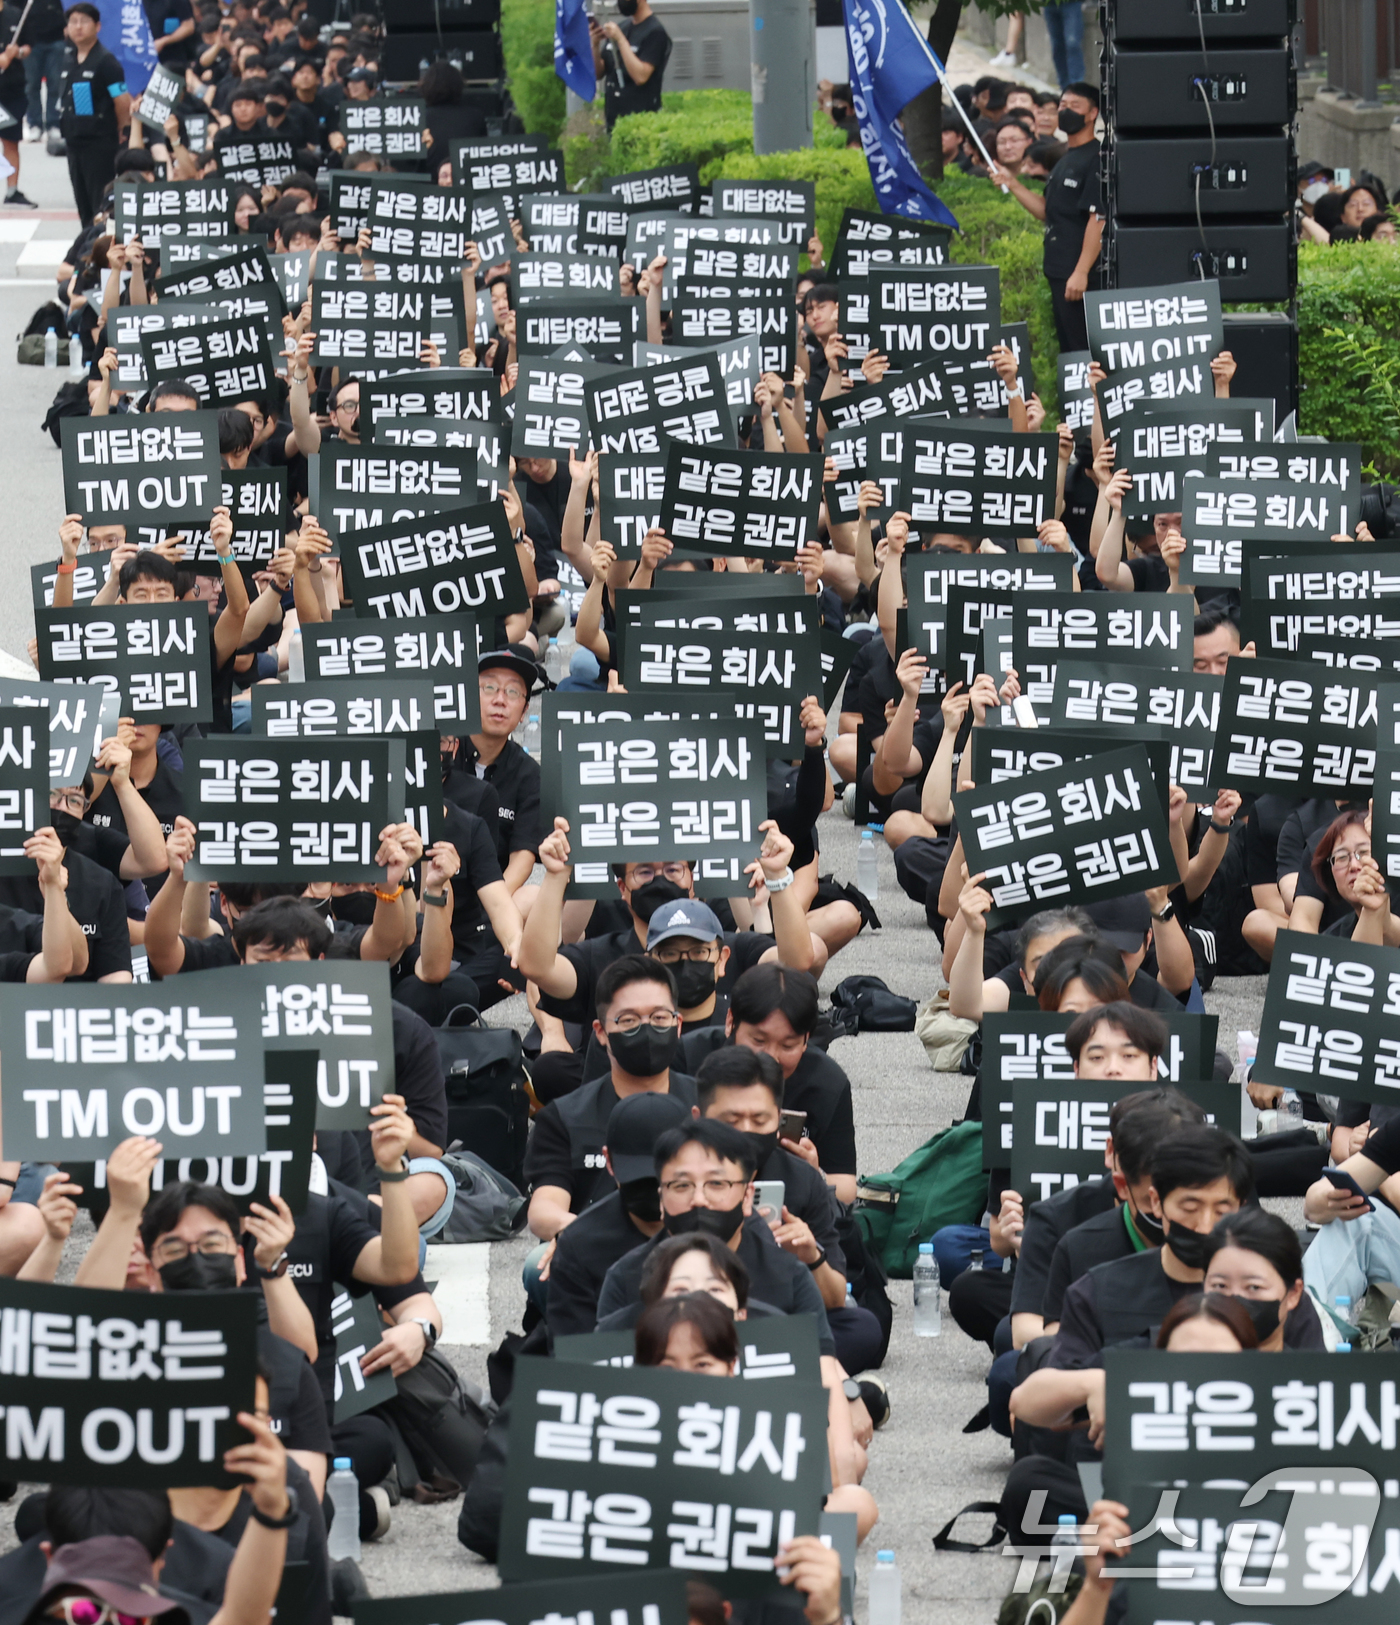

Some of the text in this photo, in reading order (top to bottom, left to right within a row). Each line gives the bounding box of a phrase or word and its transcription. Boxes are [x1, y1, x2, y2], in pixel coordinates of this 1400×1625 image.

[346, 107, 420, 128] 같은 회사
[220, 143, 291, 167] 같은 회사
[348, 133, 420, 154] 같은 권리
[264, 166, 296, 186] 권리
[471, 160, 557, 189] 같은 회사
[143, 189, 228, 216] 같은 회사
[376, 191, 416, 220] 같은
[422, 196, 466, 223] 회사
[723, 189, 805, 213] 대답없는
[372, 226, 464, 258] 같은 권리
[586, 211, 628, 235] 대답
[778, 223, 806, 243] UT
[478, 233, 504, 260] UT
[694, 250, 790, 278] 같은 회사
[214, 258, 263, 289] 회사
[519, 262, 613, 290] 같은 회사
[321, 291, 368, 319] 같은
[374, 292, 423, 320] 회사
[882, 282, 987, 311] 대답없는
[1099, 296, 1207, 329] 대답없는
[527, 317, 621, 344] 대답없는
[682, 307, 787, 339] 같은 회사
[880, 323, 989, 350] TM OUT
[152, 327, 258, 369] 같은 회사
[319, 329, 421, 358] 같은 권리
[1101, 341, 1145, 369] TM
[215, 364, 266, 397] 권리
[529, 371, 584, 405] 같은
[889, 373, 946, 418] 회사
[1104, 365, 1202, 419] 같은 회사
[434, 391, 490, 420] 회사
[78, 427, 203, 464] 대답없는
[525, 414, 580, 449] 같은
[336, 459, 461, 495] 대답없는
[915, 440, 975, 477] 같은
[984, 446, 1047, 480] 회사
[1288, 457, 1349, 491] 회사
[78, 475, 207, 512] TM OUT
[238, 482, 280, 515] 회사
[679, 457, 812, 502] 같은 회사
[1133, 471, 1175, 502] TM
[912, 488, 1043, 526] 같은 권리
[1196, 492, 1328, 530] 같은 회사
[672, 504, 806, 549] 같은 권리
[359, 524, 501, 582] 대답없는
[368, 568, 505, 619] TM OUT
[50, 618, 196, 661] 같은 회사
[1027, 609, 1097, 648] 같은
[1108, 610, 1181, 649] 회사
[317, 631, 464, 675] 같은 회사
[641, 644, 795, 688] 같은 회사
[130, 671, 197, 710] 권리
[1066, 680, 1220, 731] 같은 회사
[1237, 676, 1312, 723] 같은
[266, 698, 421, 736] 같은 회사
[578, 738, 751, 784] 같은 회사
[1227, 735, 1303, 780] 같은
[200, 760, 280, 802] 같은
[291, 760, 373, 802] 회사
[498, 807, 515, 820] SEC
[579, 800, 750, 846] 같은 권리
[971, 768, 1140, 850] 같은 회사
[199, 822, 370, 864] 같은 권리
[984, 829, 1159, 907] 같은 권리
[1286, 953, 1374, 1013] 같은
[262, 984, 372, 1036] 없는
[26, 1007, 237, 1062] 대답없는
[1275, 1021, 1362, 1080] 같은
[999, 1033, 1074, 1080] 같은
[317, 1060, 378, 1107] UT
[24, 1090, 108, 1138] TM
[122, 1086, 241, 1137] OUT
[287, 1264, 313, 1277] ECU
[1129, 1381, 1400, 1450] 같은 회사
[82, 1407, 229, 1463] OUT
[535, 1391, 805, 1480] 같은 회사
[527, 1488, 795, 1577] 같은 권리
